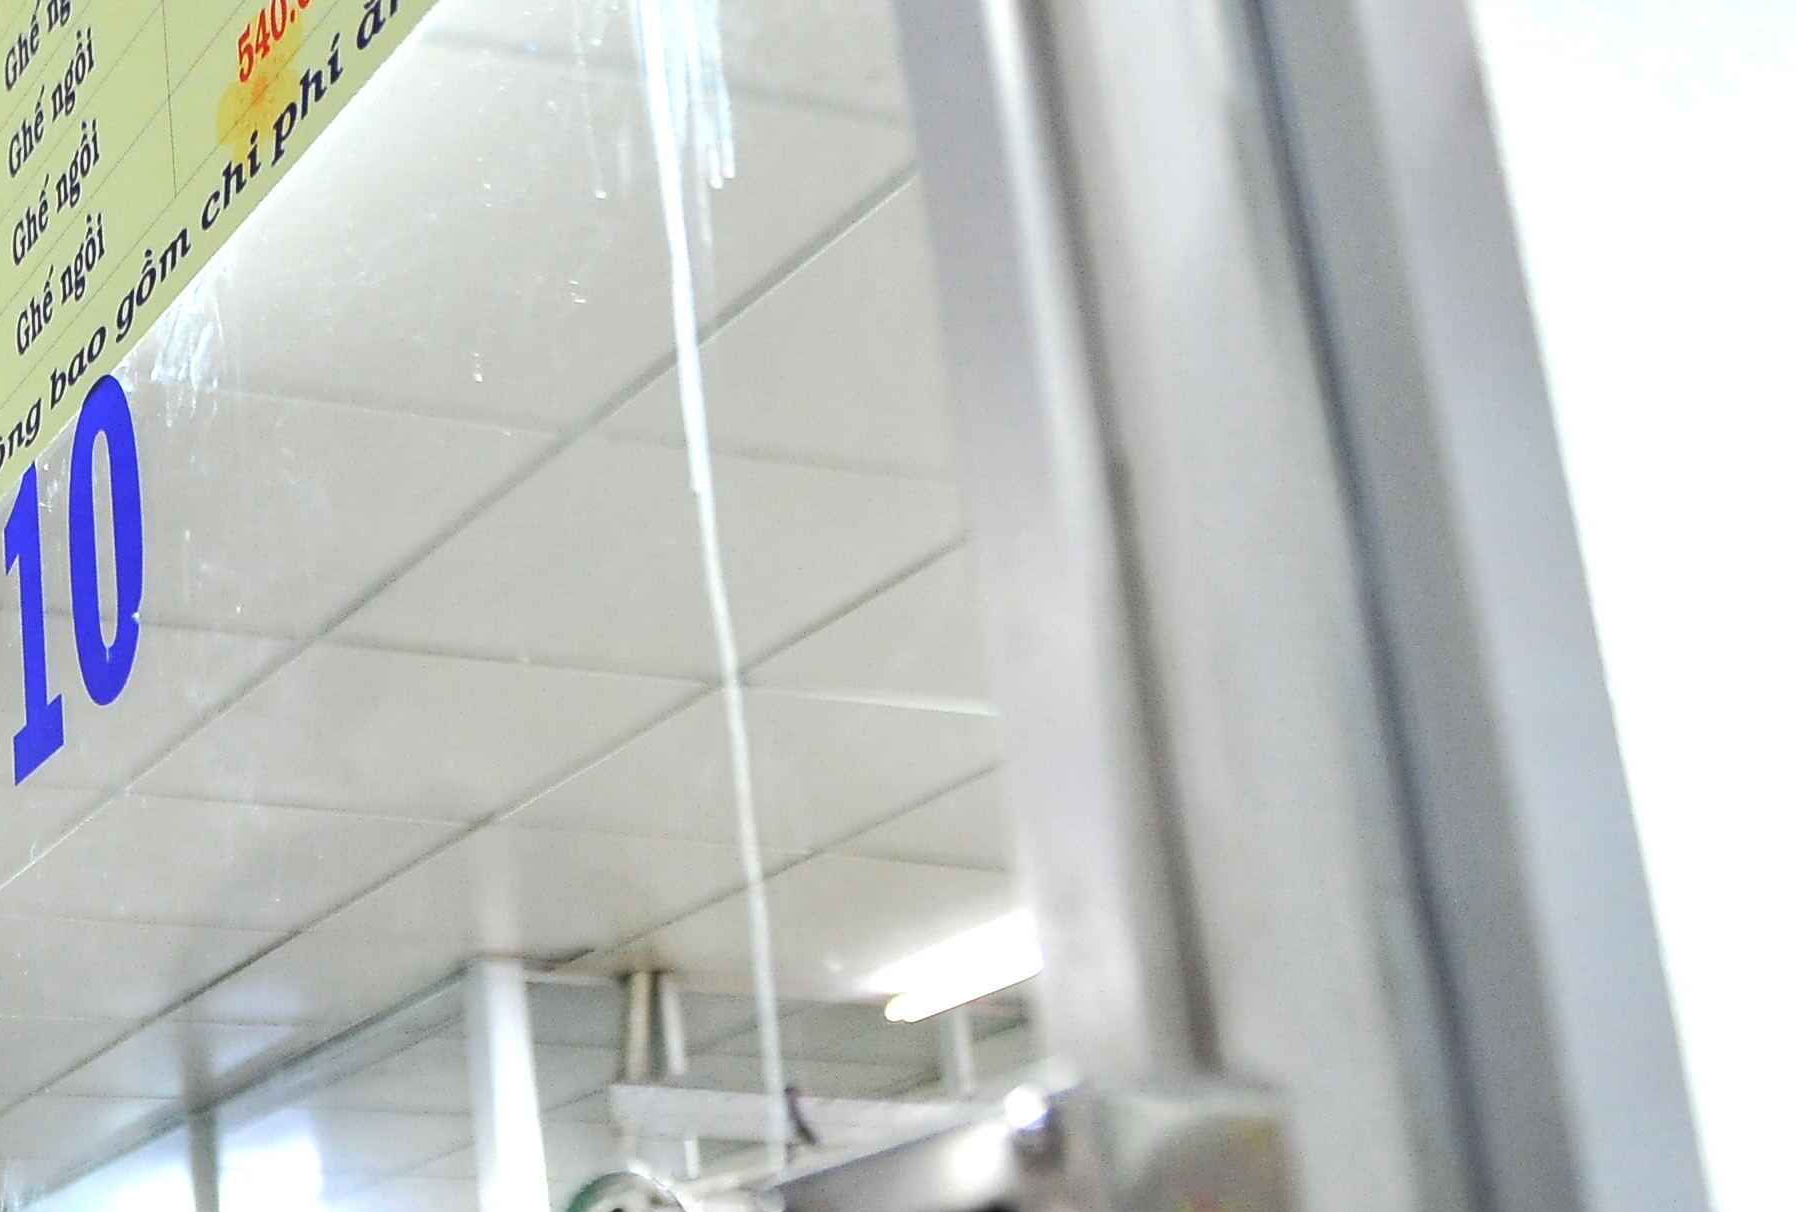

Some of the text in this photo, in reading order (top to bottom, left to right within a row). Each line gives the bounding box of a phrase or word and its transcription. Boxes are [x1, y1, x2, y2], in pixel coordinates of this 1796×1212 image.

[4, 0, 41, 92] Ghế
[8, 84, 45, 178] Ghế
[50, 26, 95, 123] ngồi
[13, 173, 49, 267] Ghế
[55, 118, 100, 215] ngồi
[17, 264, 54, 356] Ghế
[60, 212, 106, 305] ngồi
[236, 0, 312, 83] 540.
[49, 325, 108, 411] bao
[114, 226, 192, 344] gồm
[200, 129, 262, 231] chi
[270, 31, 344, 168] phí
[3, 373, 145, 787] 10
